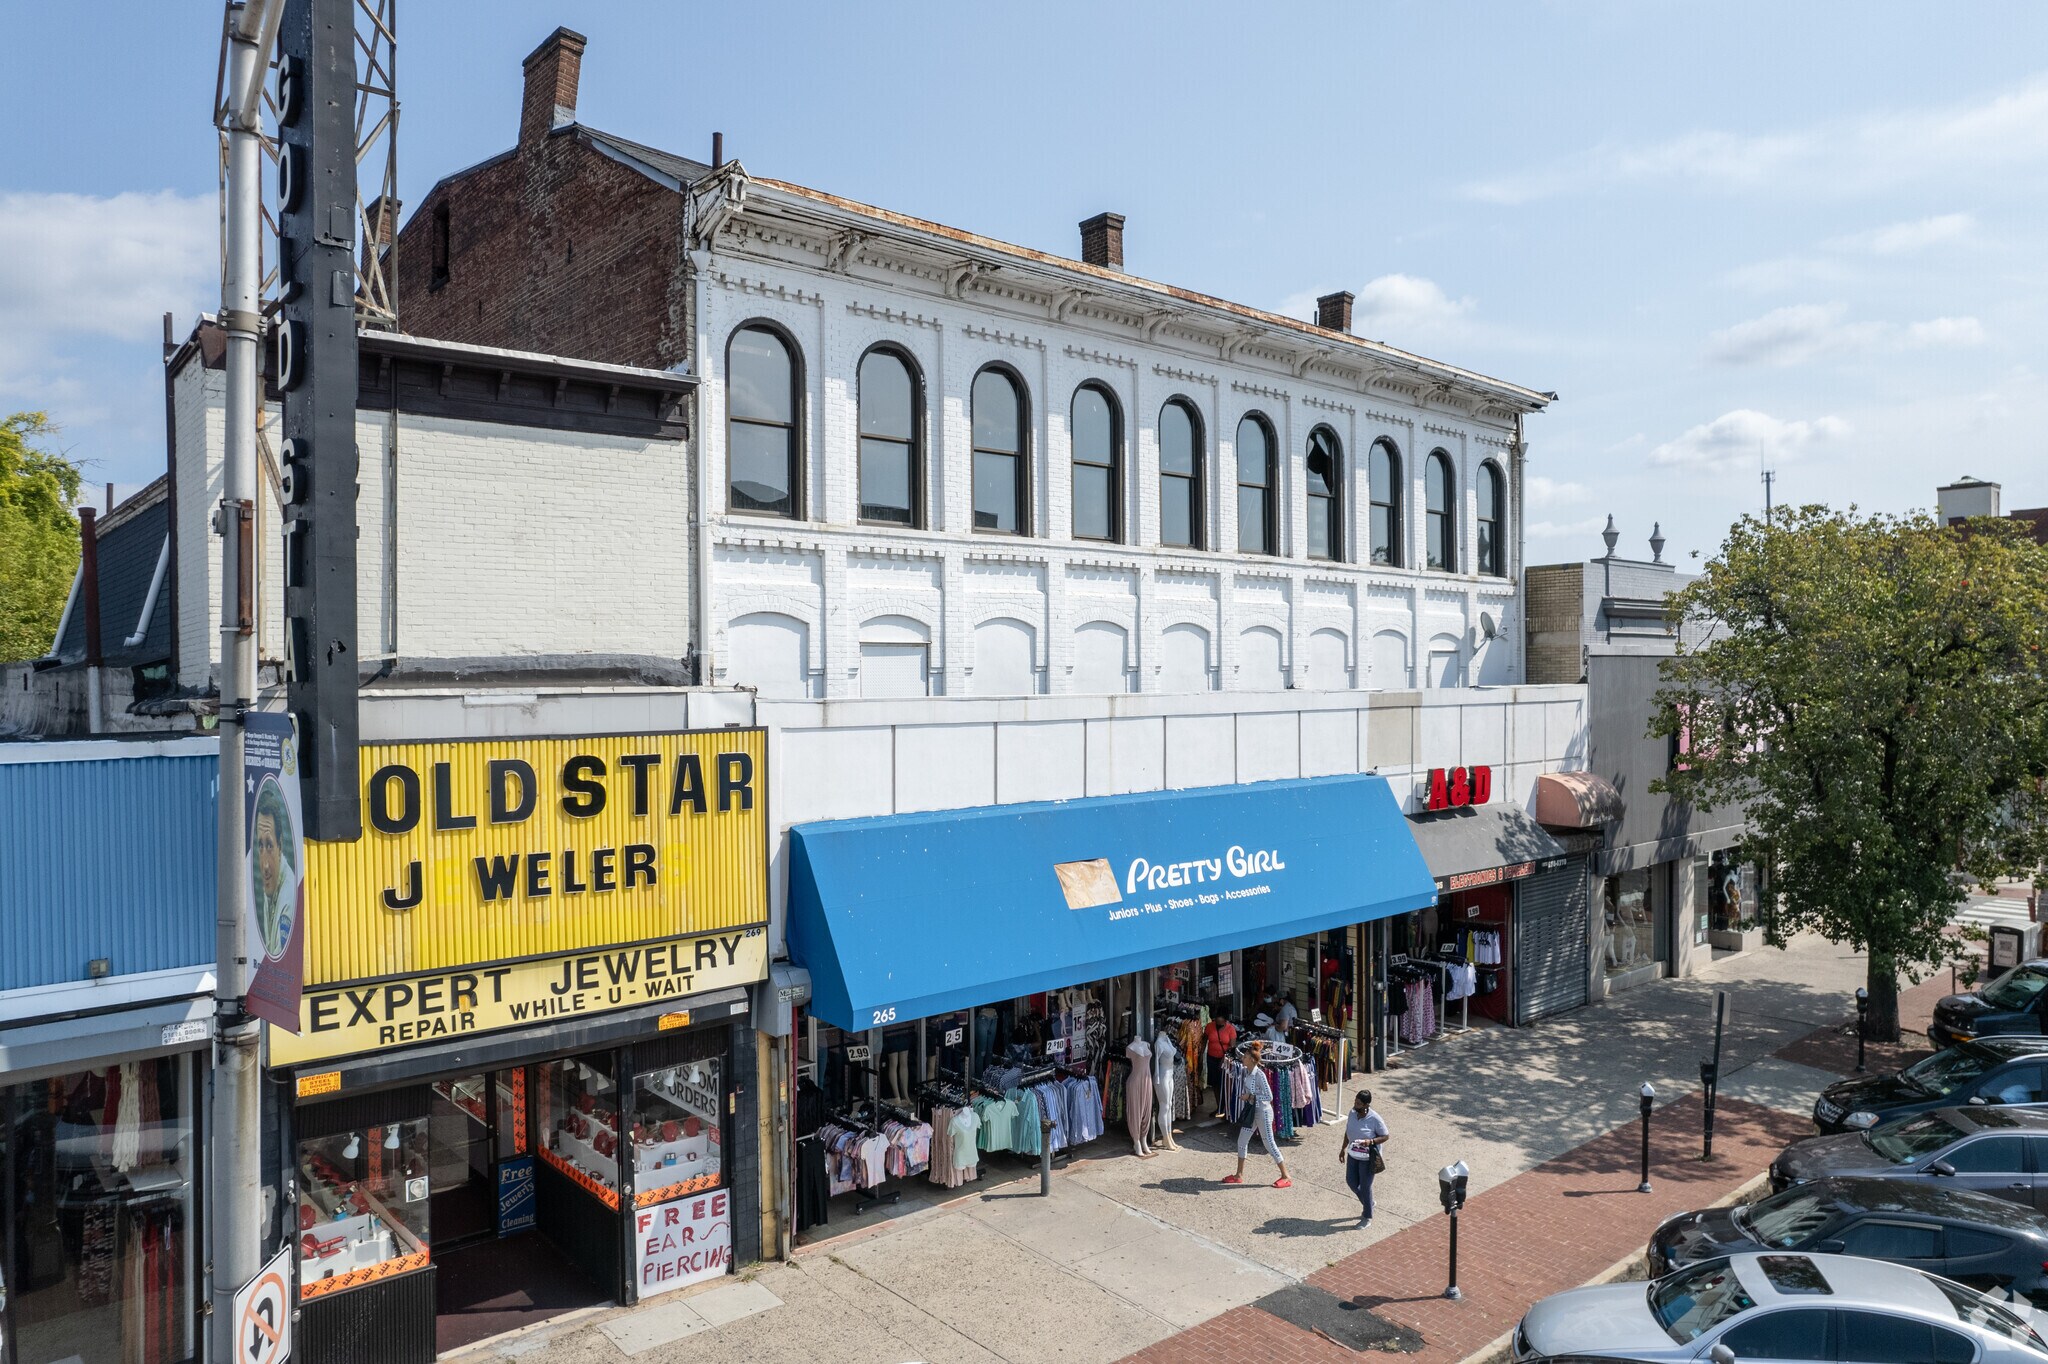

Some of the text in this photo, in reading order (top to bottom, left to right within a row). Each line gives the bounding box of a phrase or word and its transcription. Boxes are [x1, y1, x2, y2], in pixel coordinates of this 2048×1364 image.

[275, 53, 297, 391] GOLD
[369, 752, 754, 835] OLD STAR
[1426, 765, 1492, 811] A&D
[474, 843, 658, 902] WELER
[1126, 845, 1286, 895] PRETTY GIRL
[1450, 867, 1497, 890] ELECTRONICS
[1108, 884, 1271, 921] Juniors Plus Shoes Bags Accessories
[745, 928, 762, 938] 269
[1391, 954, 1407, 965] 3.99
[309, 933, 743, 1034] EXPERT JEWELRY
[379, 1011, 476, 1045] REPAIR
[509, 993, 586, 1021] WHILE
[644, 974, 695, 999] WAIT
[873, 1007, 897, 1025] 265
[848, 1047, 870, 1059] 2.99
[300, 1073, 340, 1083] AMERICAN
[672, 1064, 718, 1096] USOM
[668, 1081, 718, 1117] ORDERS
[501, 1166, 533, 1183] Free
[501, 1213, 534, 1229] Cleaning
[637, 1193, 727, 1234] FREE
[645, 1226, 695, 1257] EAR
